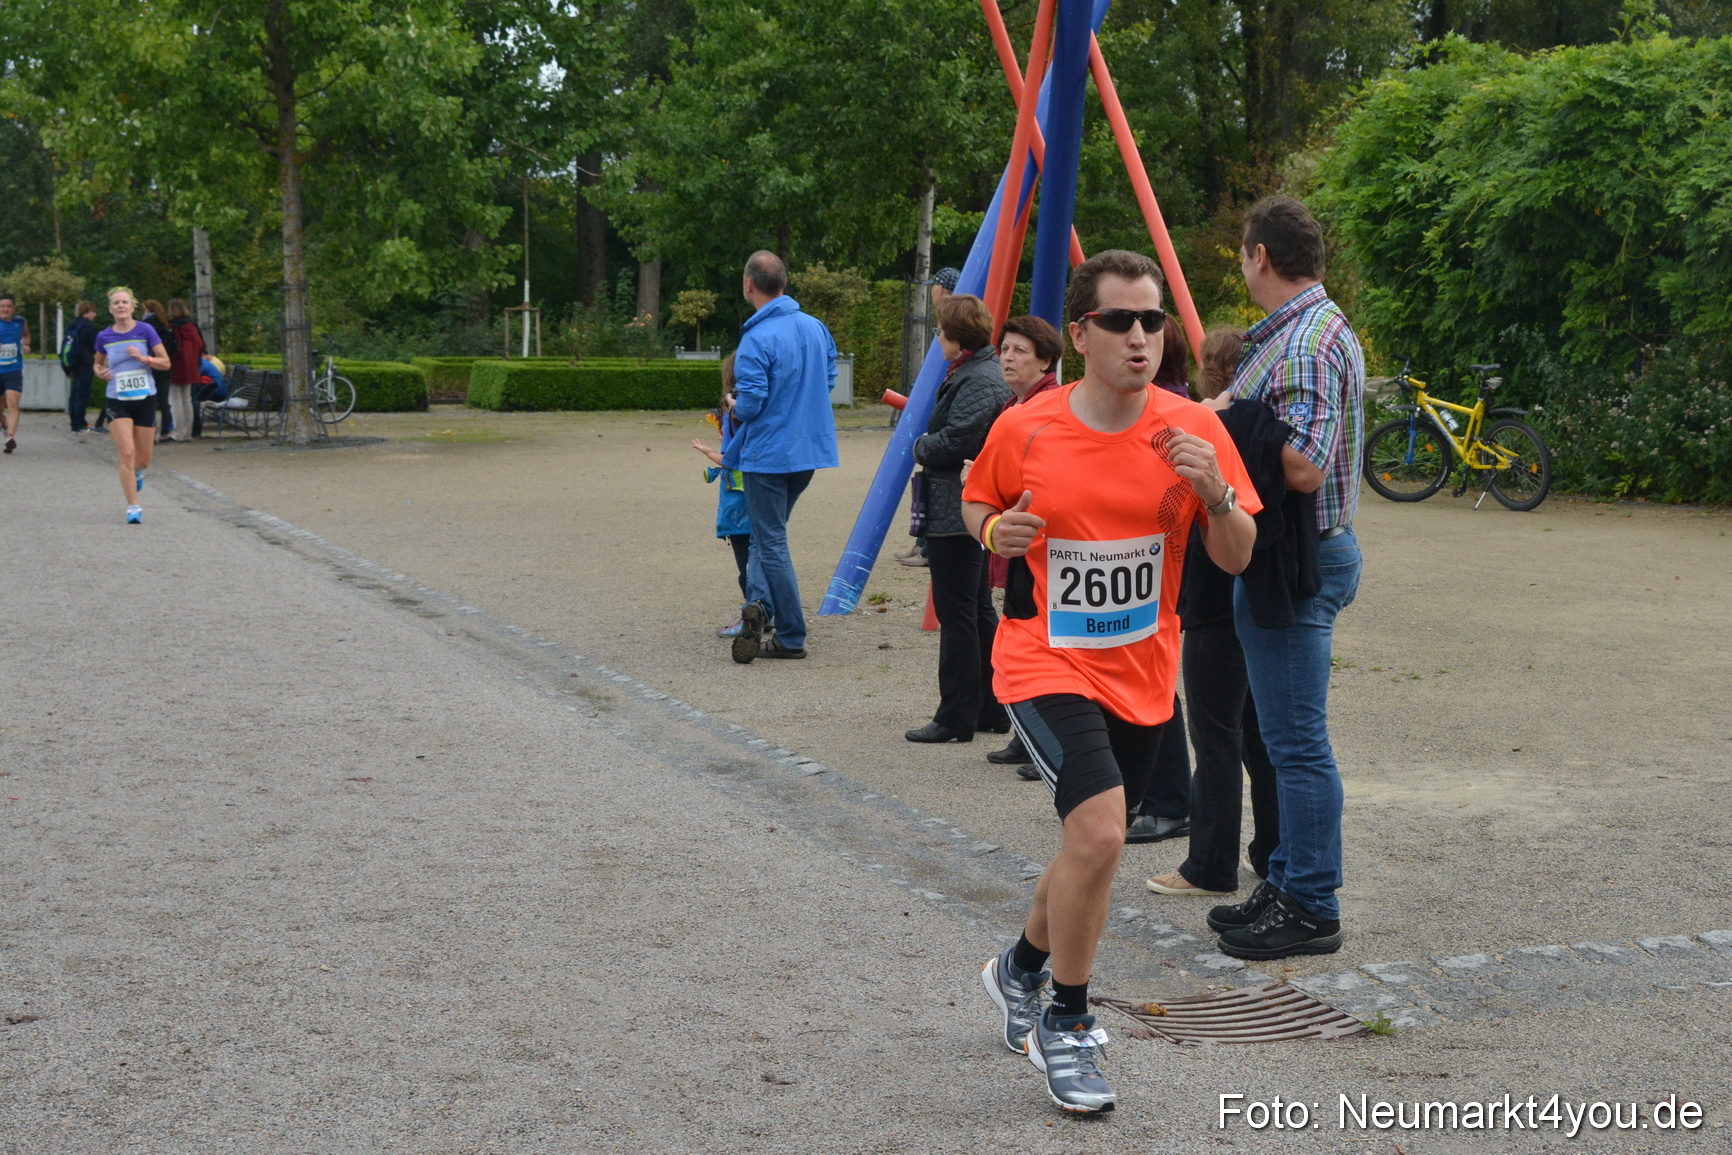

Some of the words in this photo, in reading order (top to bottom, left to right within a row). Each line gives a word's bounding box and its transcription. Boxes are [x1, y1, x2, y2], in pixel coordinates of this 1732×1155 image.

[119, 376, 146, 390] 3403
[1049, 549, 1088, 562] PARTL
[1090, 548, 1146, 562] Neumarkt
[1060, 561, 1154, 608] 2600
[1052, 602, 1058, 610] B
[1086, 615, 1130, 634] Bernd
